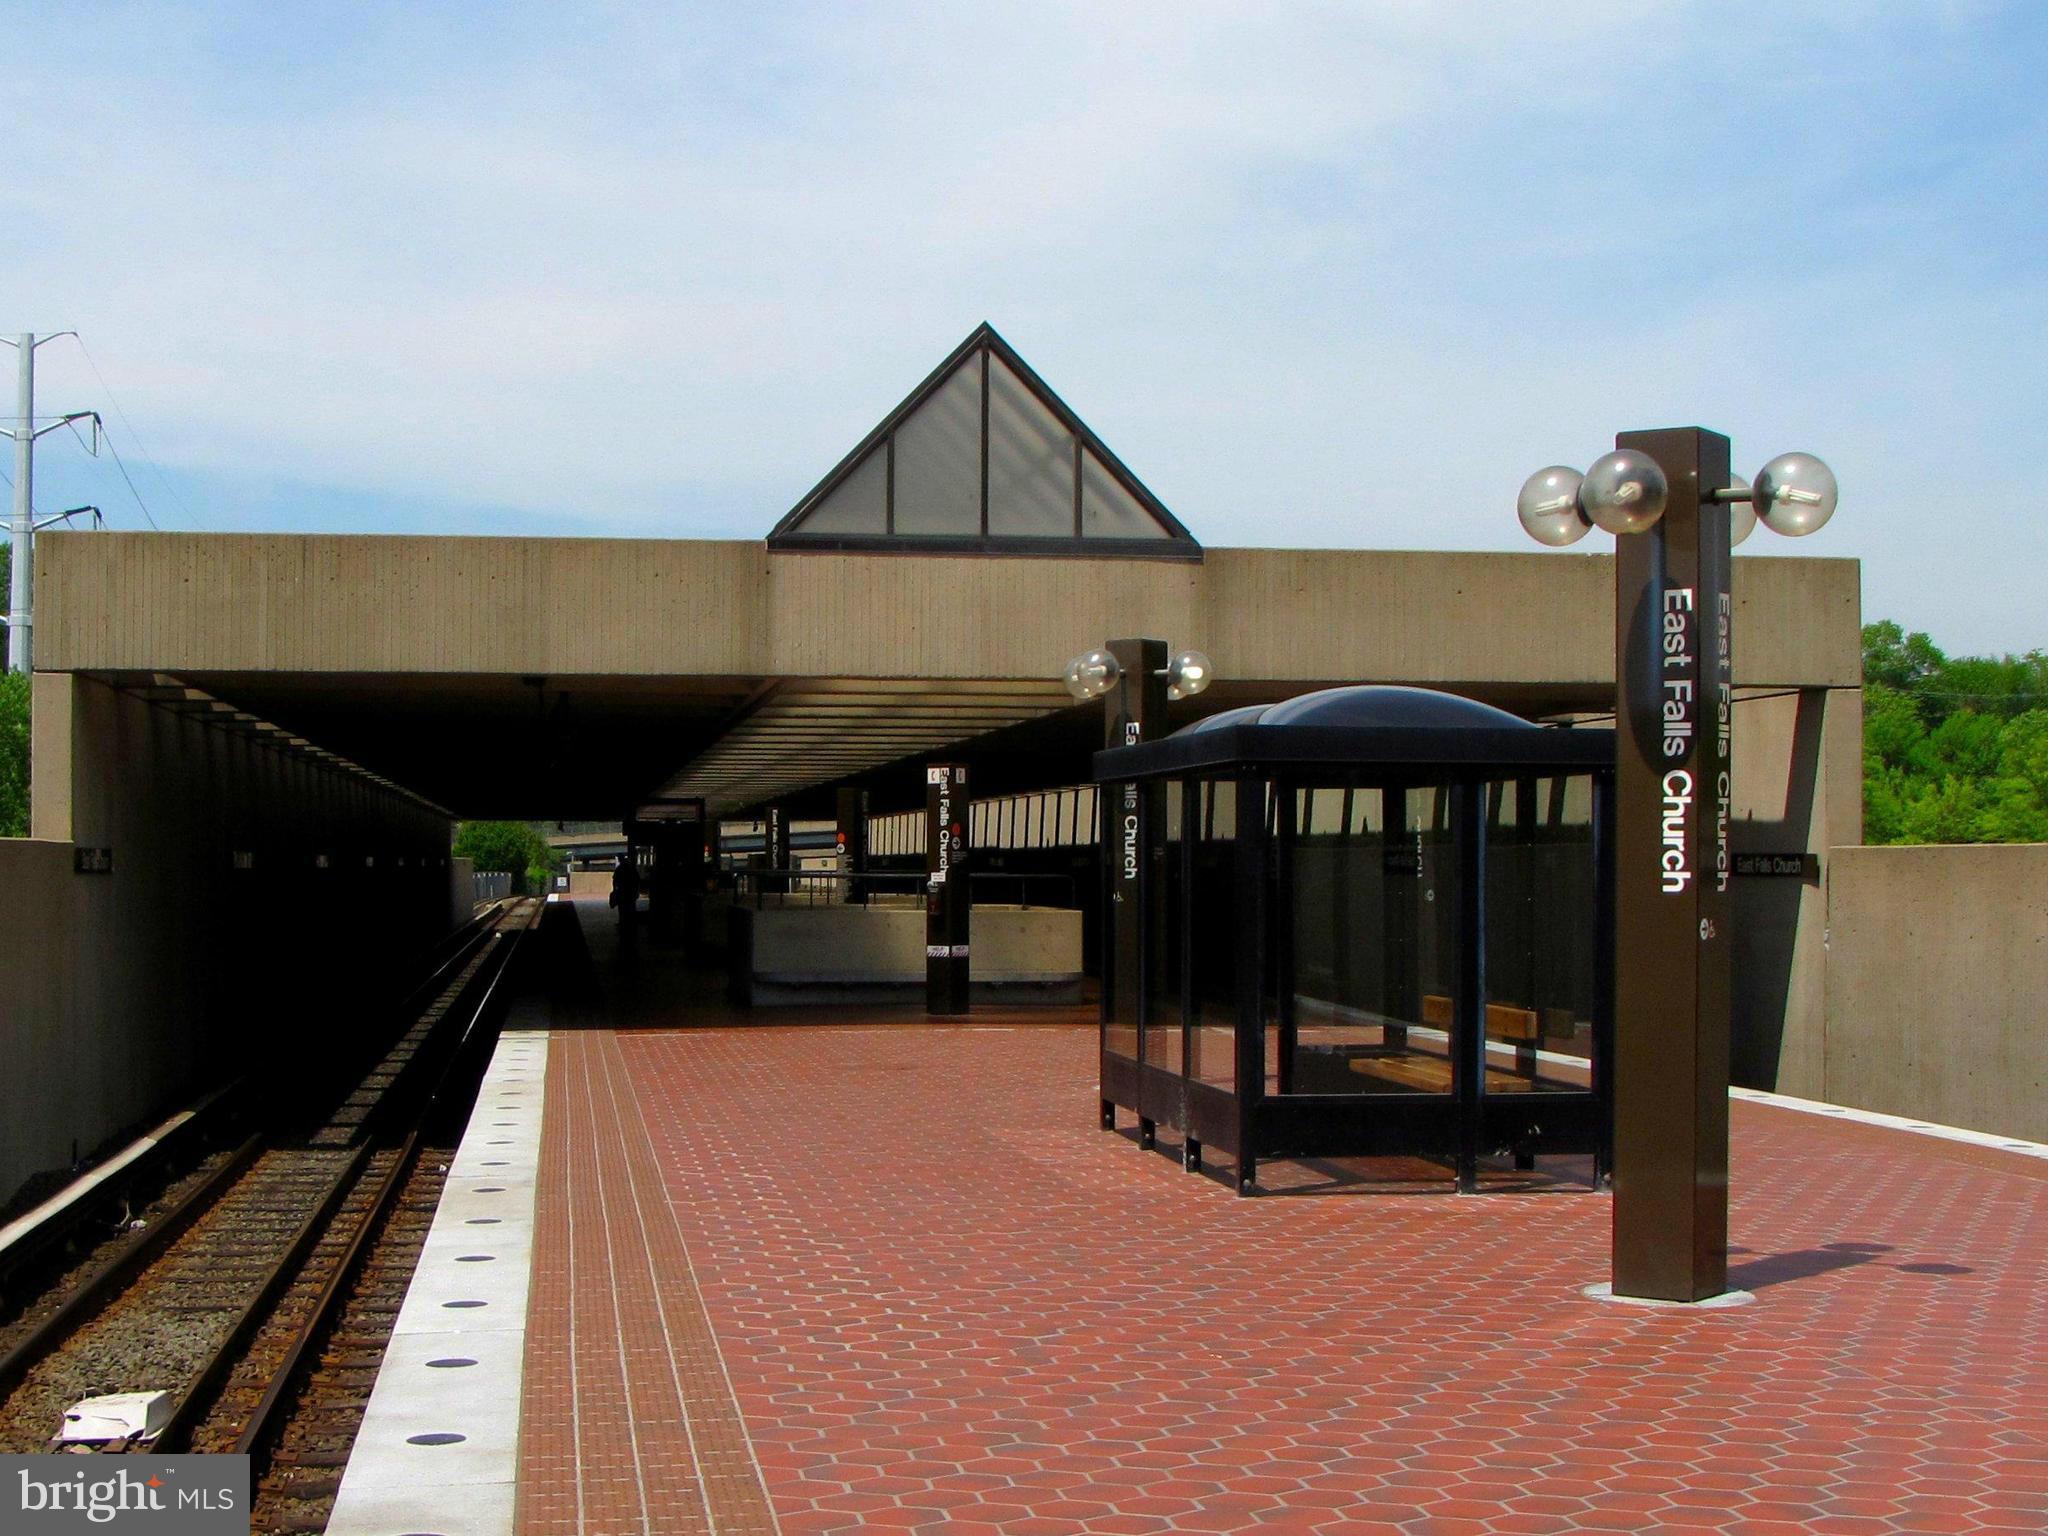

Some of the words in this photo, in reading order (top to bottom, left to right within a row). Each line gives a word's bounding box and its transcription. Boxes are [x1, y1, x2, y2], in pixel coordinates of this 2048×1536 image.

[1662, 588, 1693, 668] East
[1717, 592, 1730, 669] East
[1125, 721, 1140, 746] Ea
[1662, 680, 1692, 756] Falls
[1717, 684, 1730, 758] Falls
[939, 768, 950, 795] East
[939, 799, 950, 826] Falls
[939, 829, 950, 873] Church
[1124, 815, 1138, 879] Church
[1661, 769, 1692, 893] Church
[1716, 771, 1730, 892] Church
